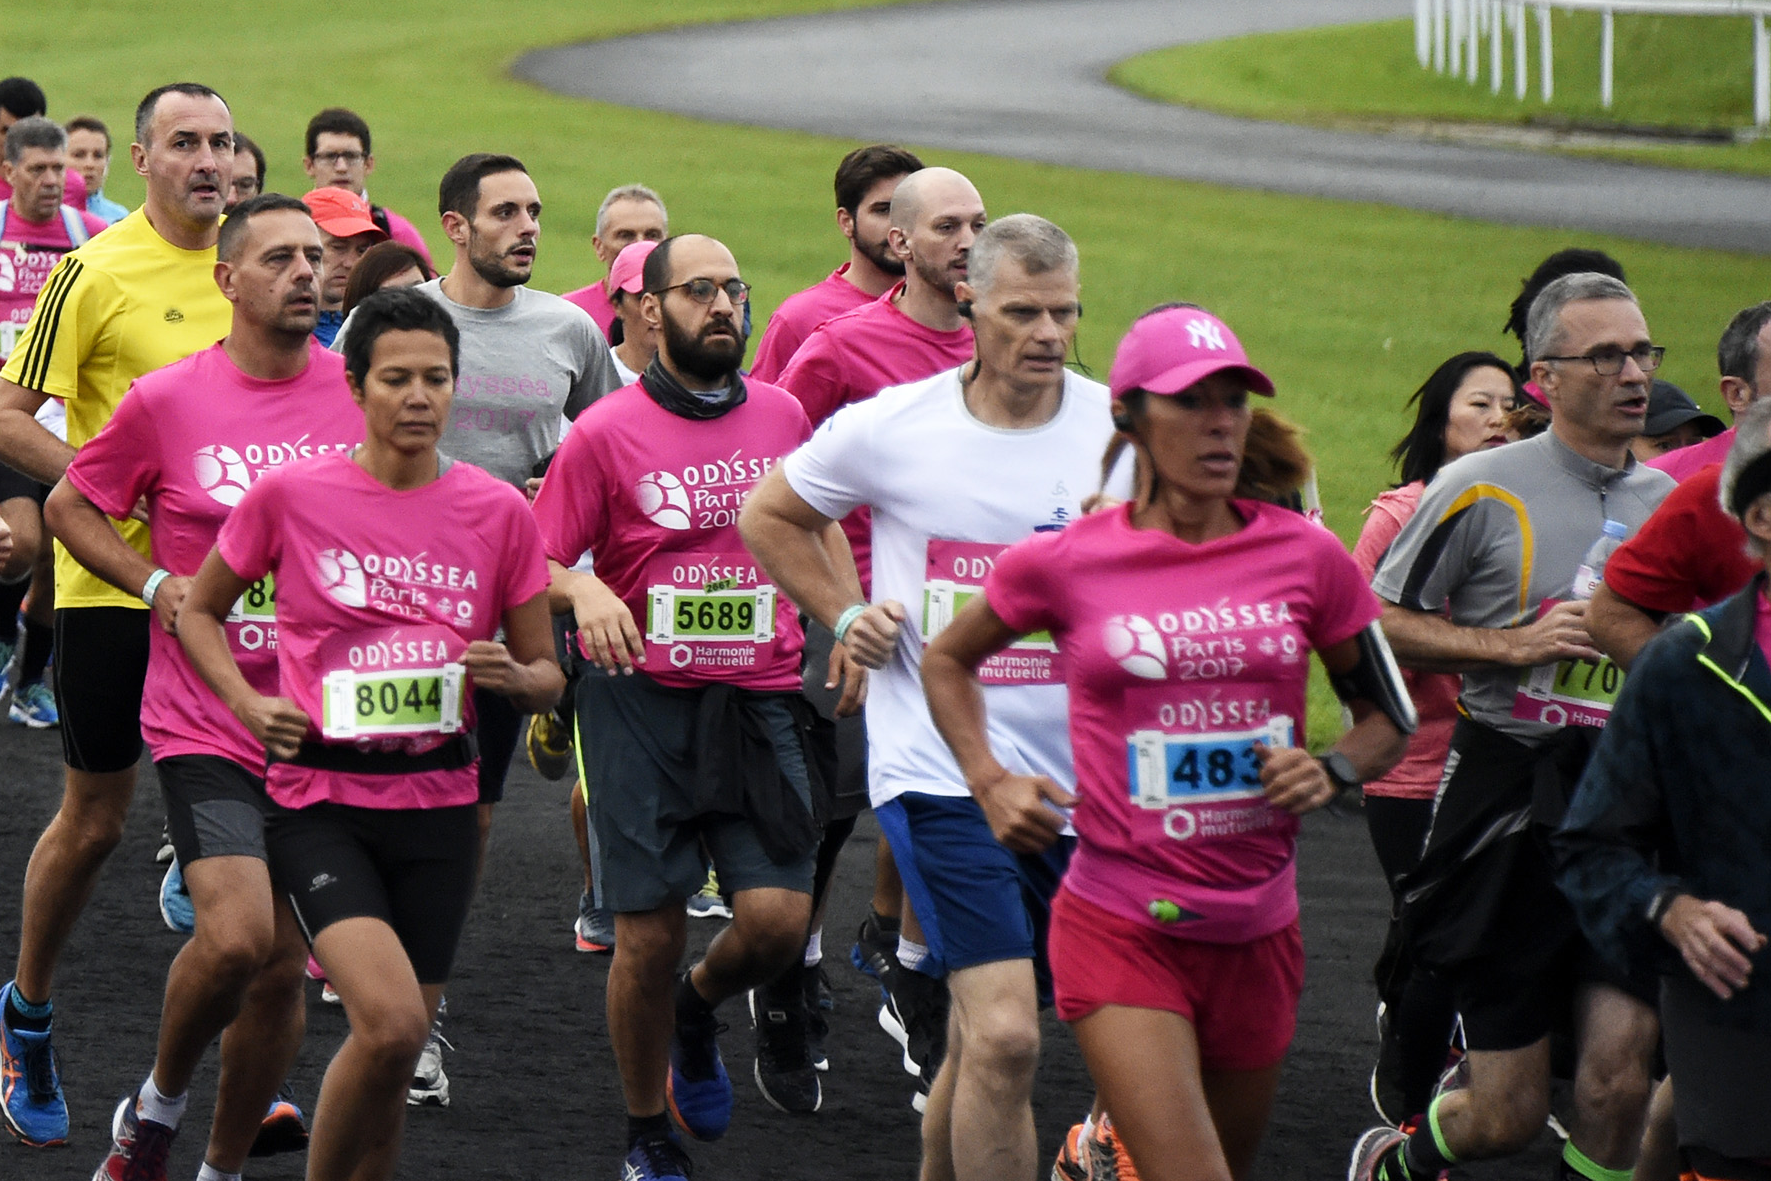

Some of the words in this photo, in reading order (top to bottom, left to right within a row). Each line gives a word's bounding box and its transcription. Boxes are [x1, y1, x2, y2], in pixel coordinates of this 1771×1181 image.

[455, 406, 536, 432] 2017
[699, 507, 740, 529] 201
[370, 578, 428, 606] Paris
[677, 601, 753, 630] 5689
[696, 646, 756, 657] Harmonie
[1173, 636, 1246, 659] Paris
[695, 656, 756, 666] mutuelle
[979, 666, 1051, 679] mutuelle
[1179, 657, 1248, 680] 2017
[1561, 659, 1619, 694] 770
[357, 678, 441, 717] 8044
